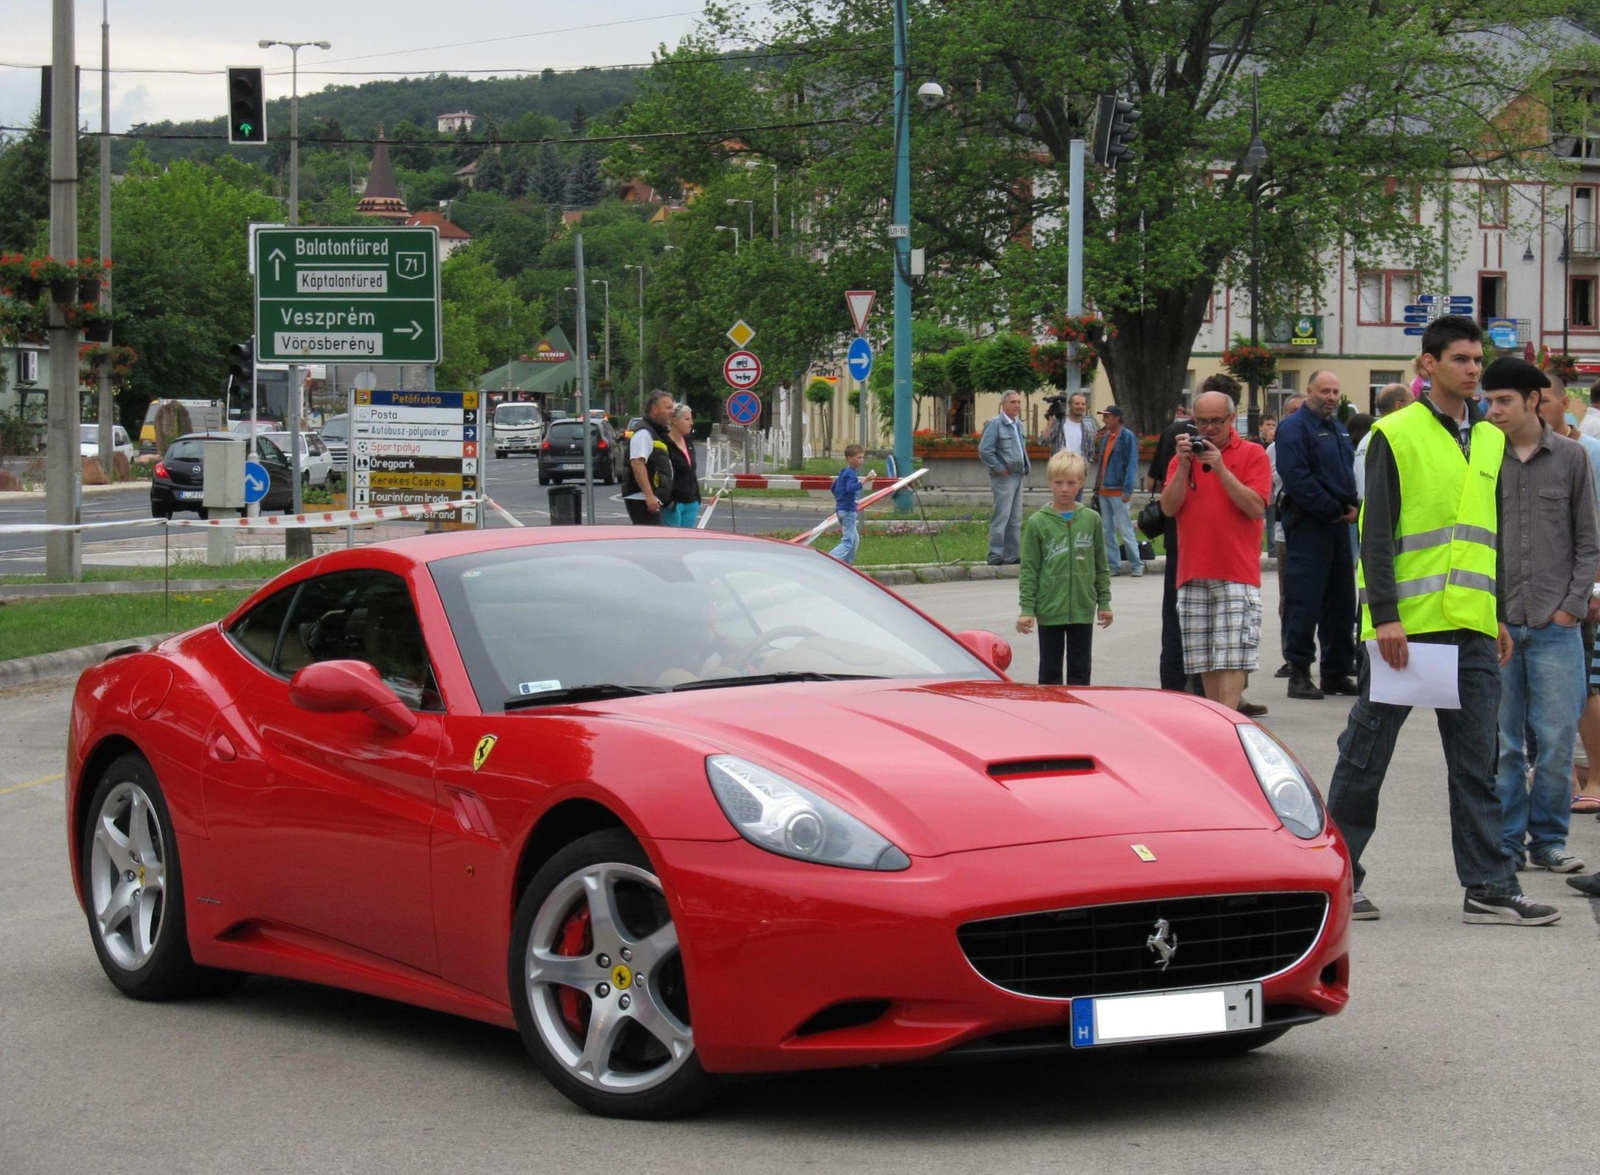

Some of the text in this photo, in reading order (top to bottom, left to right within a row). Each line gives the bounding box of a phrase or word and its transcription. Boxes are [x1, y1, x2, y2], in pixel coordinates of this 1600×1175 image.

[295, 237, 389, 255] Balatonfüred
[405, 258, 418, 272] 71
[302, 273, 383, 290] Káptalanfüred
[281, 306, 375, 329] Veszprém
[281, 336, 375, 354] Vörösberény
[421, 394, 442, 404] utca
[371, 409, 398, 419] Posta
[371, 425, 449, 438] Autóbusz-pályaudvar
[371, 442, 421, 454] Sportpálya
[371, 476, 446, 487] Kerekes Csárda
[370, 491, 449, 502] Tourinform Iroda
[1078, 1026, 1089, 1040] H
